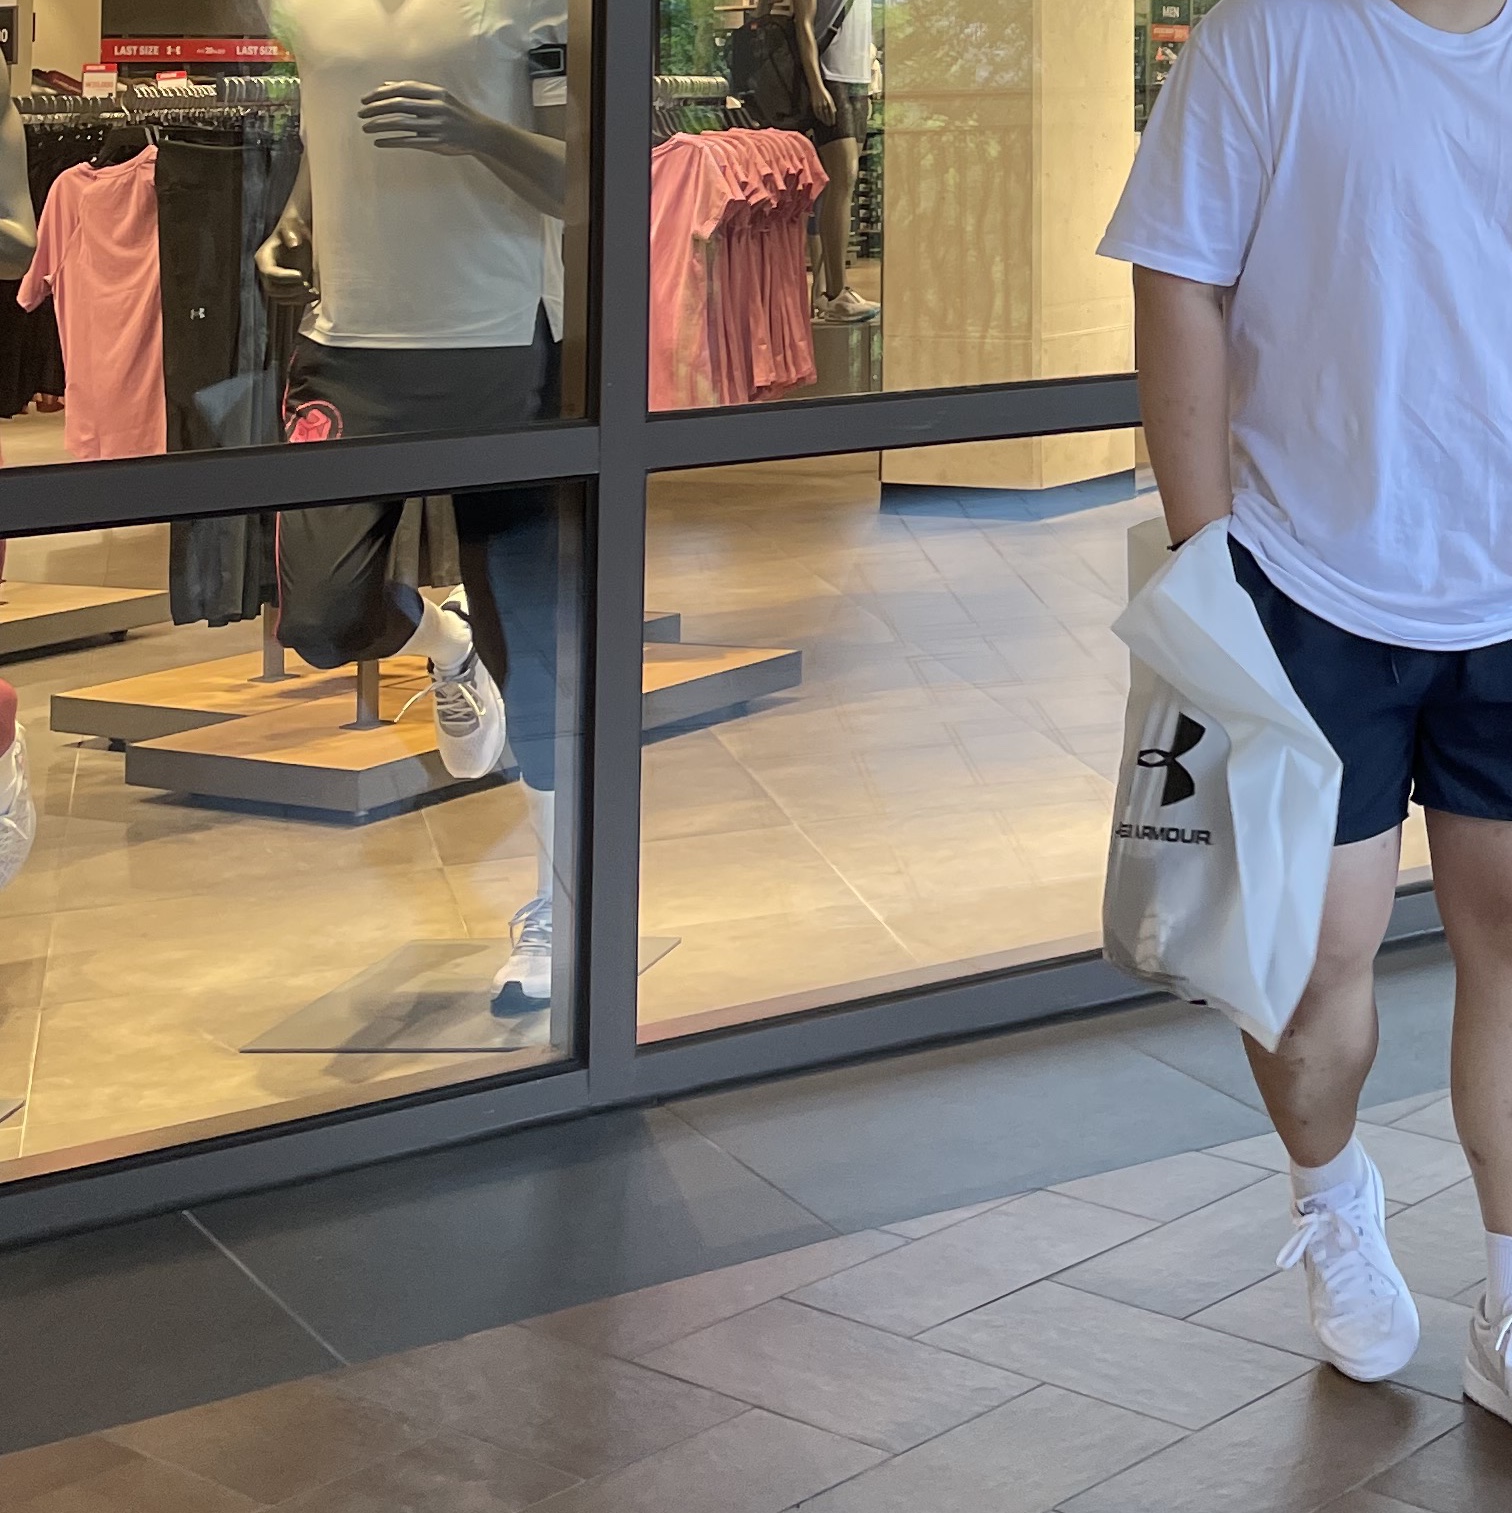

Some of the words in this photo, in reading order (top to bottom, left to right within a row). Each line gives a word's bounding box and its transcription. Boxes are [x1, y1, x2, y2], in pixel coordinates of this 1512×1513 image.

[114, 45, 137, 56] LAST
[139, 45, 160, 56] SIZE
[236, 45, 258, 56] LAST
[259, 45, 279, 56] SIZE
